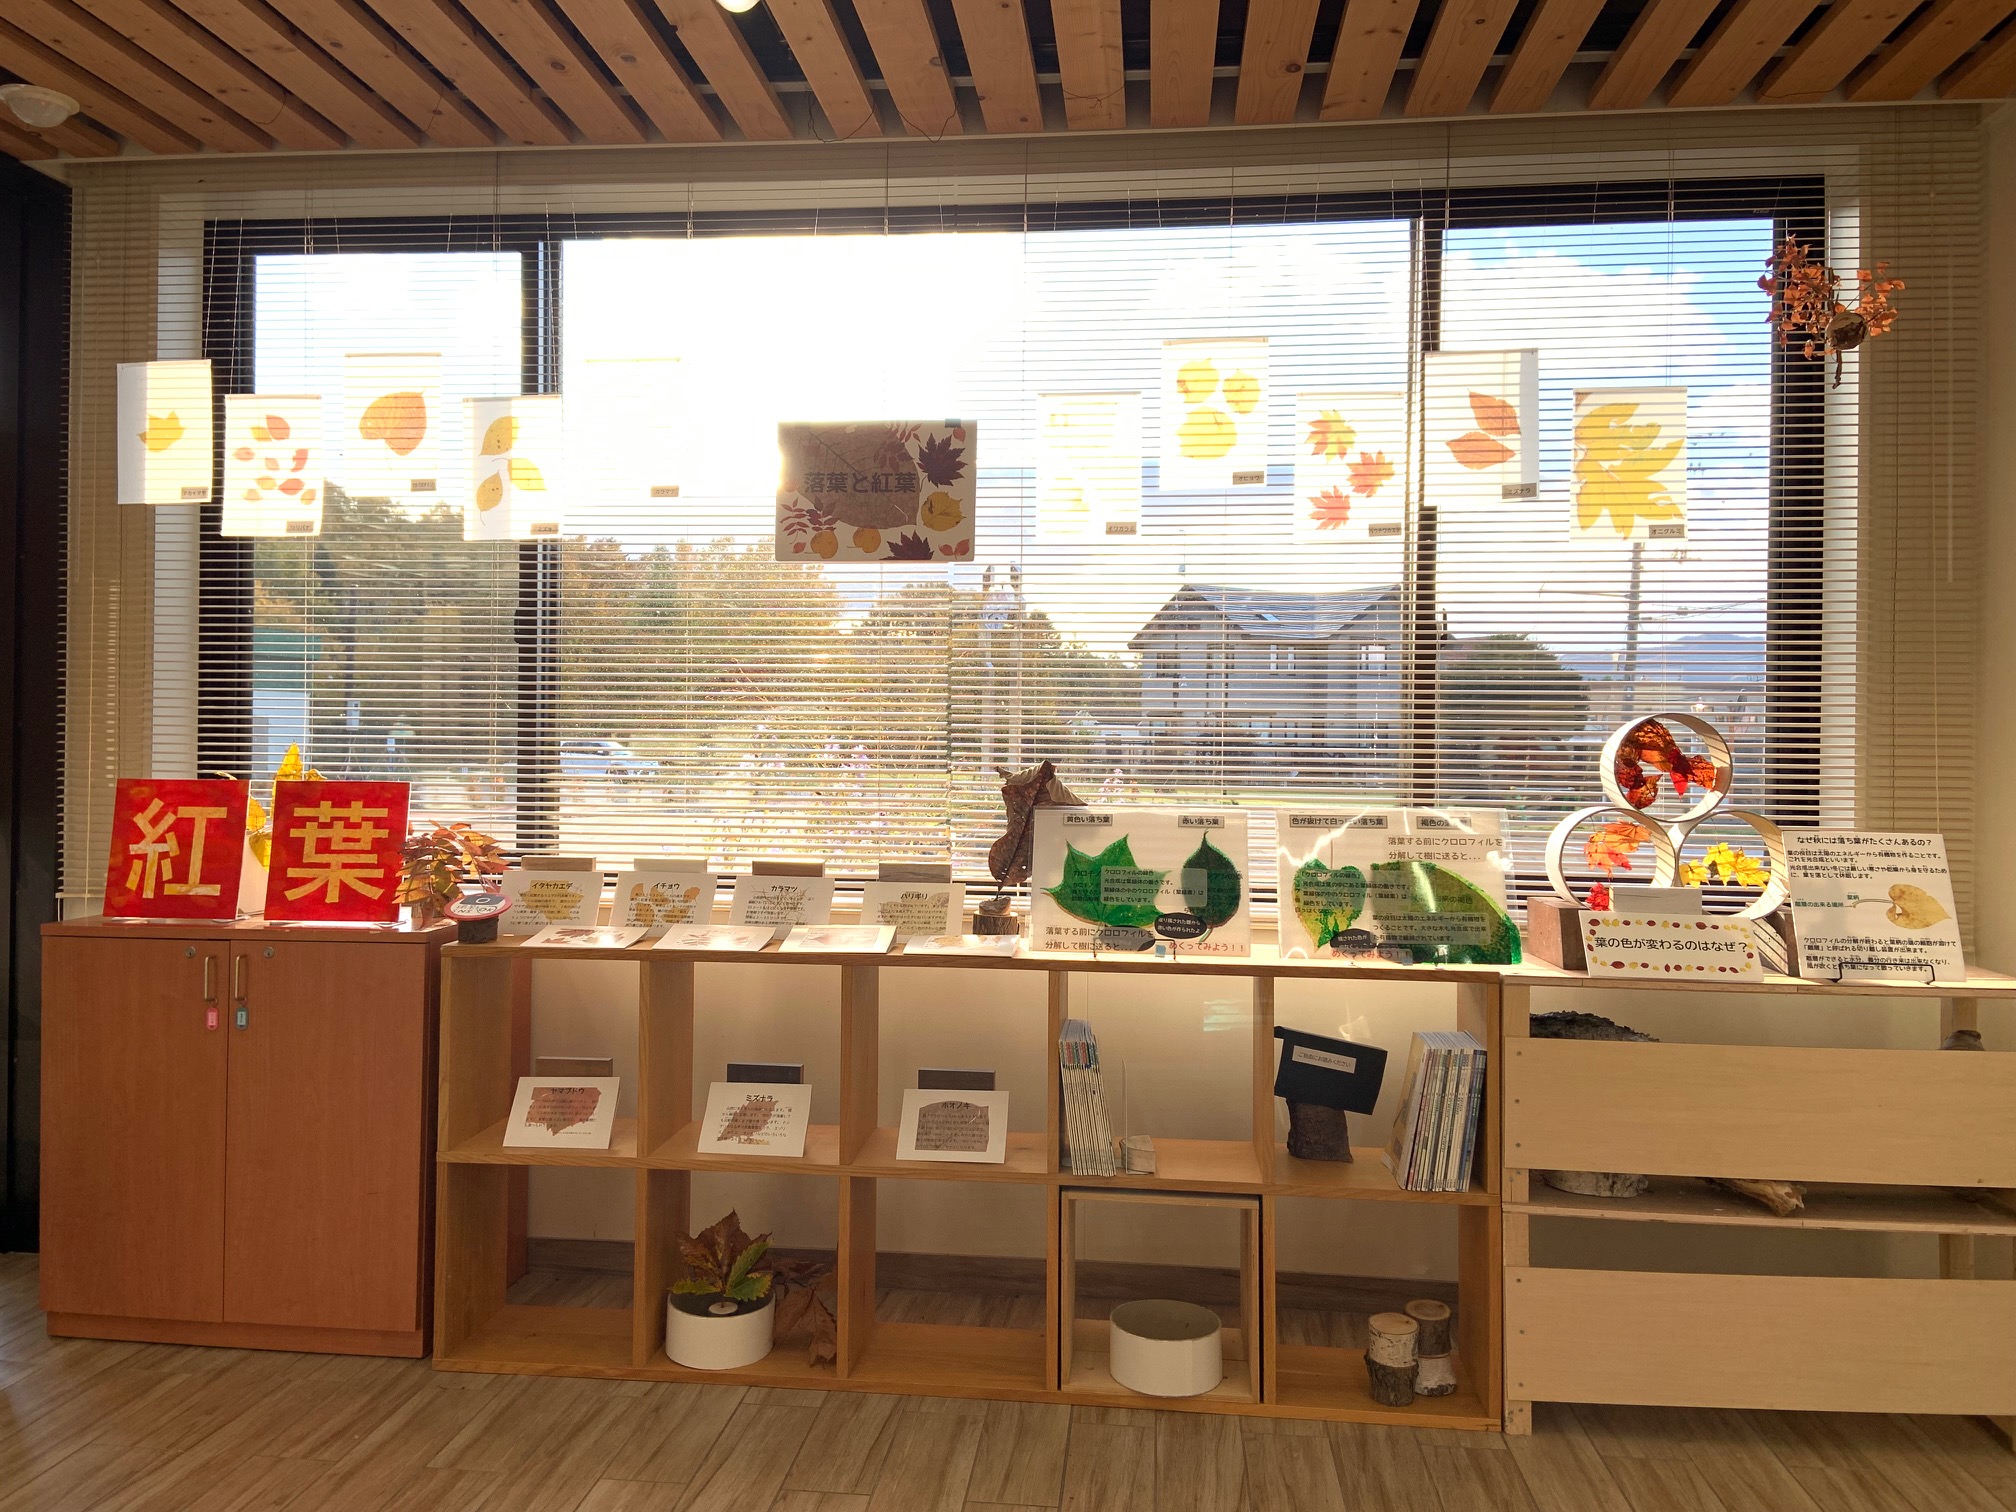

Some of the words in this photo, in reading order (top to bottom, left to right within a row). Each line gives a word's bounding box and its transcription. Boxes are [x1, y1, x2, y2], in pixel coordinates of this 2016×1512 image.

[804, 472, 917, 494] 落葉と紅葉
[1066, 815, 1111, 824] 黄色い落ち葉
[1182, 817, 1220, 826] 赤い落ち葉
[1388, 836, 1503, 847] 落葉する前にクロロフィルを
[1797, 836, 1932, 846] なぜ秋には落ち葉がたくさんあるの？
[125, 797, 228, 900] 紅
[284, 800, 390, 904] 葉
[532, 882, 574, 890] イタヤカエデ
[653, 882, 681, 890] イチョウ
[770, 885, 798, 893] カラマツ
[1045, 926, 1154, 938] 落葉する前にクロロフィルを
[1594, 937, 1748, 953] 葉の色が変わるのはなぜ？
[550, 1087, 585, 1095] ヤマブドウ
[745, 1094, 774, 1102] ミズナラ
[941, 1102, 971, 1110] ホオノキ
